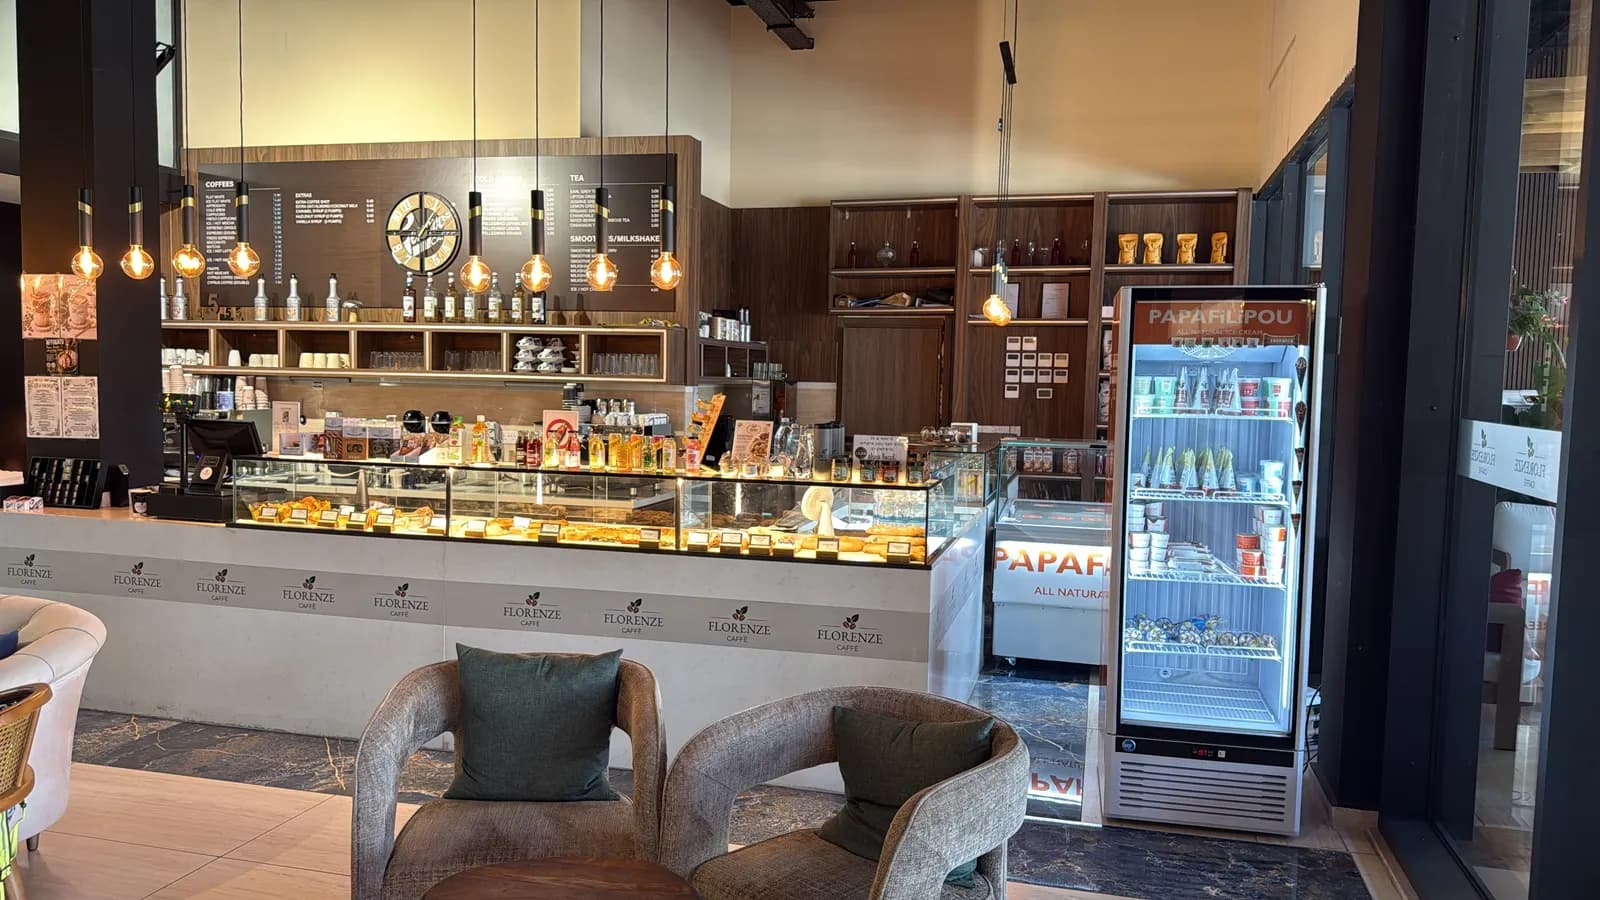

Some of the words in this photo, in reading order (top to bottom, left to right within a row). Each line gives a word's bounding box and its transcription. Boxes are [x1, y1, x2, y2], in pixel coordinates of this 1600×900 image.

[569, 174, 584, 182] TEA
[7, 567, 53, 579] FLORENZE
[113, 575, 161, 588] FLORENZE
[197, 582, 246, 596] FLORENZE
[1034, 586, 1055, 596] ALL
[283, 590, 336, 603] FLORENZE
[374, 597, 429, 611] FLORENZE
[503, 607, 561, 620] FLORENZE
[604, 613, 664, 627] FLORENZE
[708, 621, 771, 636] FLORENZE
[817, 630, 883, 644] FLORENZE
